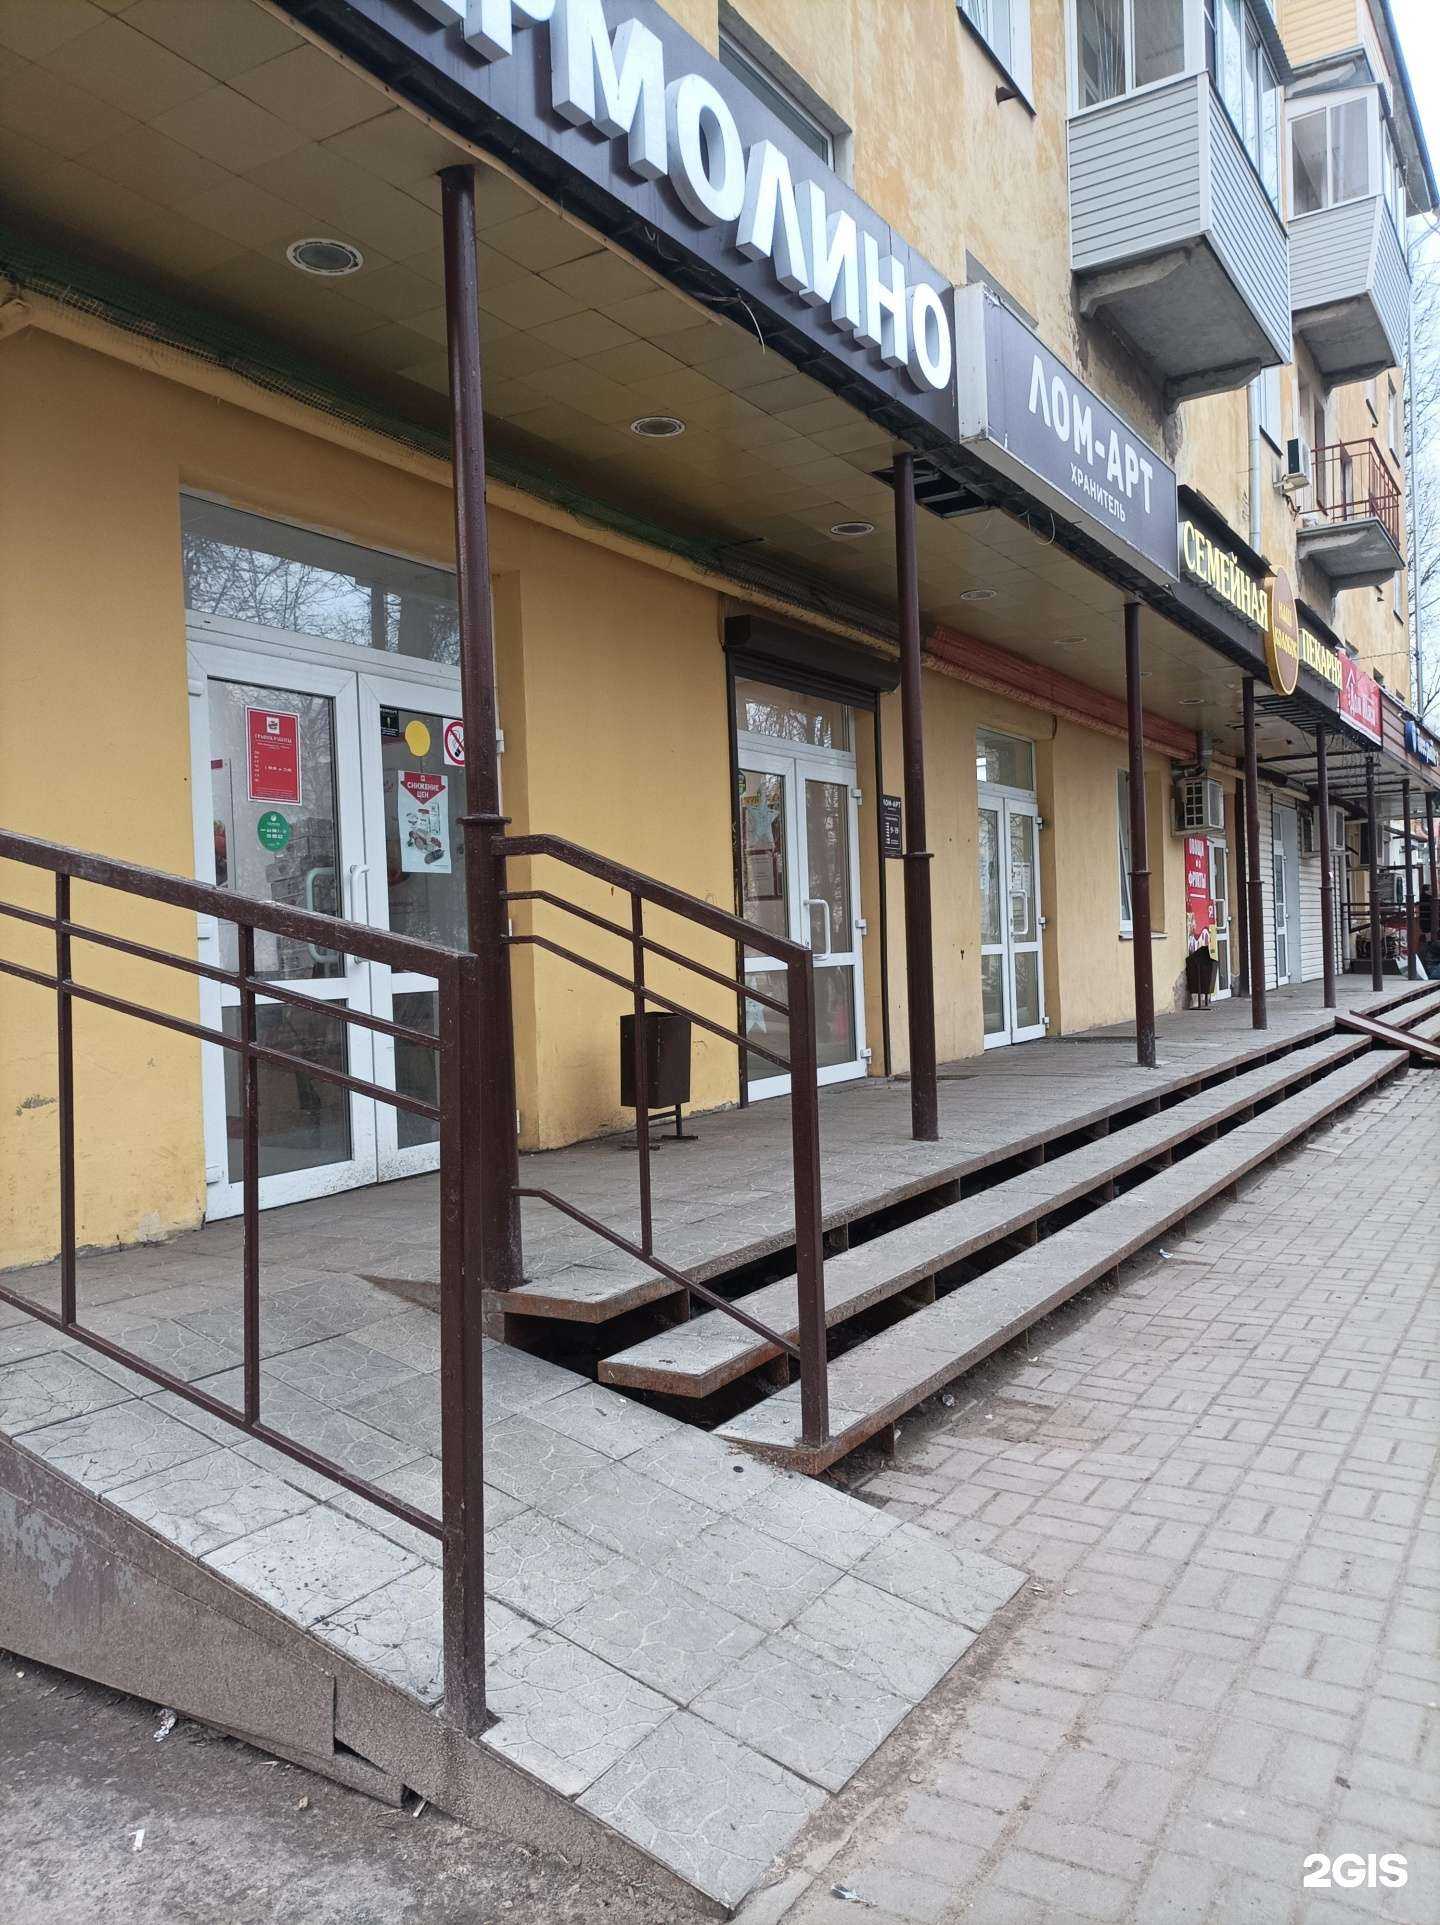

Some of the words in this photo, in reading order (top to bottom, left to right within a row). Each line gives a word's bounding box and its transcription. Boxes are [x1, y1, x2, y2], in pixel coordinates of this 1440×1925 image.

[1028, 354, 1153, 515] ЛОМ-АРТ
[1070, 462, 1126, 523] ХРАНИТЕЛЬ
[406, 781, 440, 792] СНИЖЕНИЕ
[416, 790, 429, 799] ЦЕН
